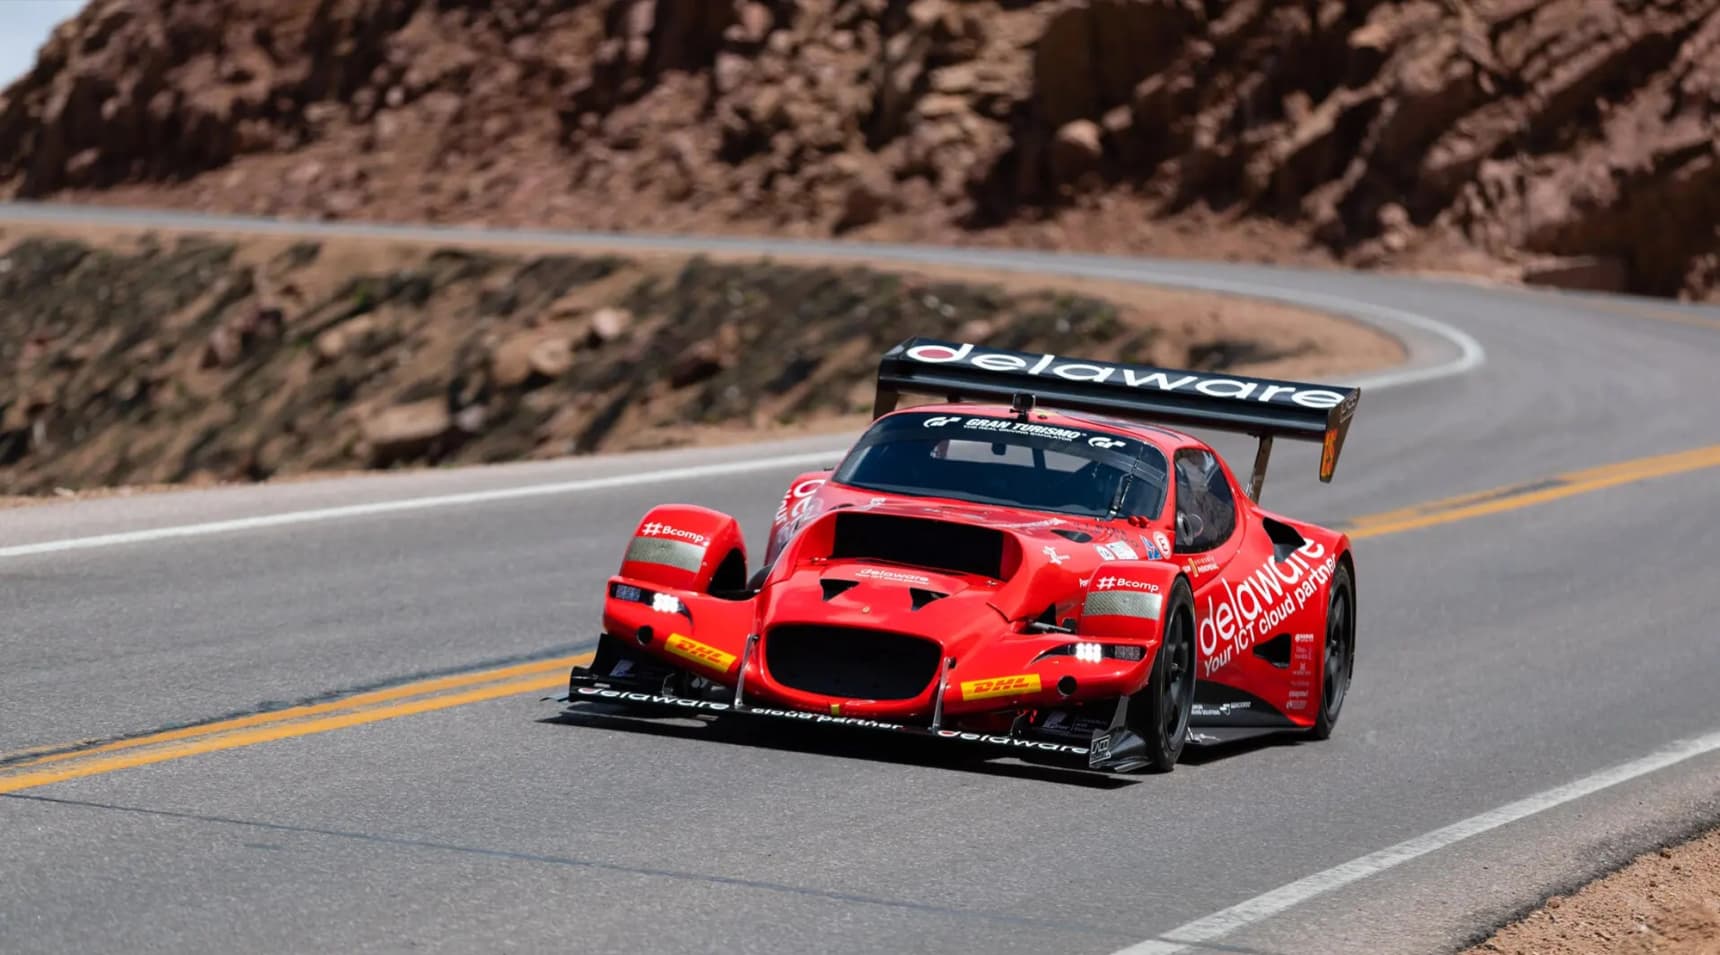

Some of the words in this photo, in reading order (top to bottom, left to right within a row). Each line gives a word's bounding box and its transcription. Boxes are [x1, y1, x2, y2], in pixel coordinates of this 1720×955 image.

[907, 342, 1344, 408] delaware
[965, 418, 1011, 429] GRAN
[1200, 538, 1324, 656] delaware
[1204, 645, 1232, 677] Your
[1234, 621, 1256, 654] ICT
[1258, 593, 1296, 635] cloud
[1294, 553, 1337, 609] partner
[676, 640, 723, 663] DHL
[974, 677, 1029, 693] DHL
[577, 686, 731, 710] delaware
[751, 707, 817, 720] cloud
[817, 713, 904, 730] partner
[937, 729, 1090, 754] delaware
